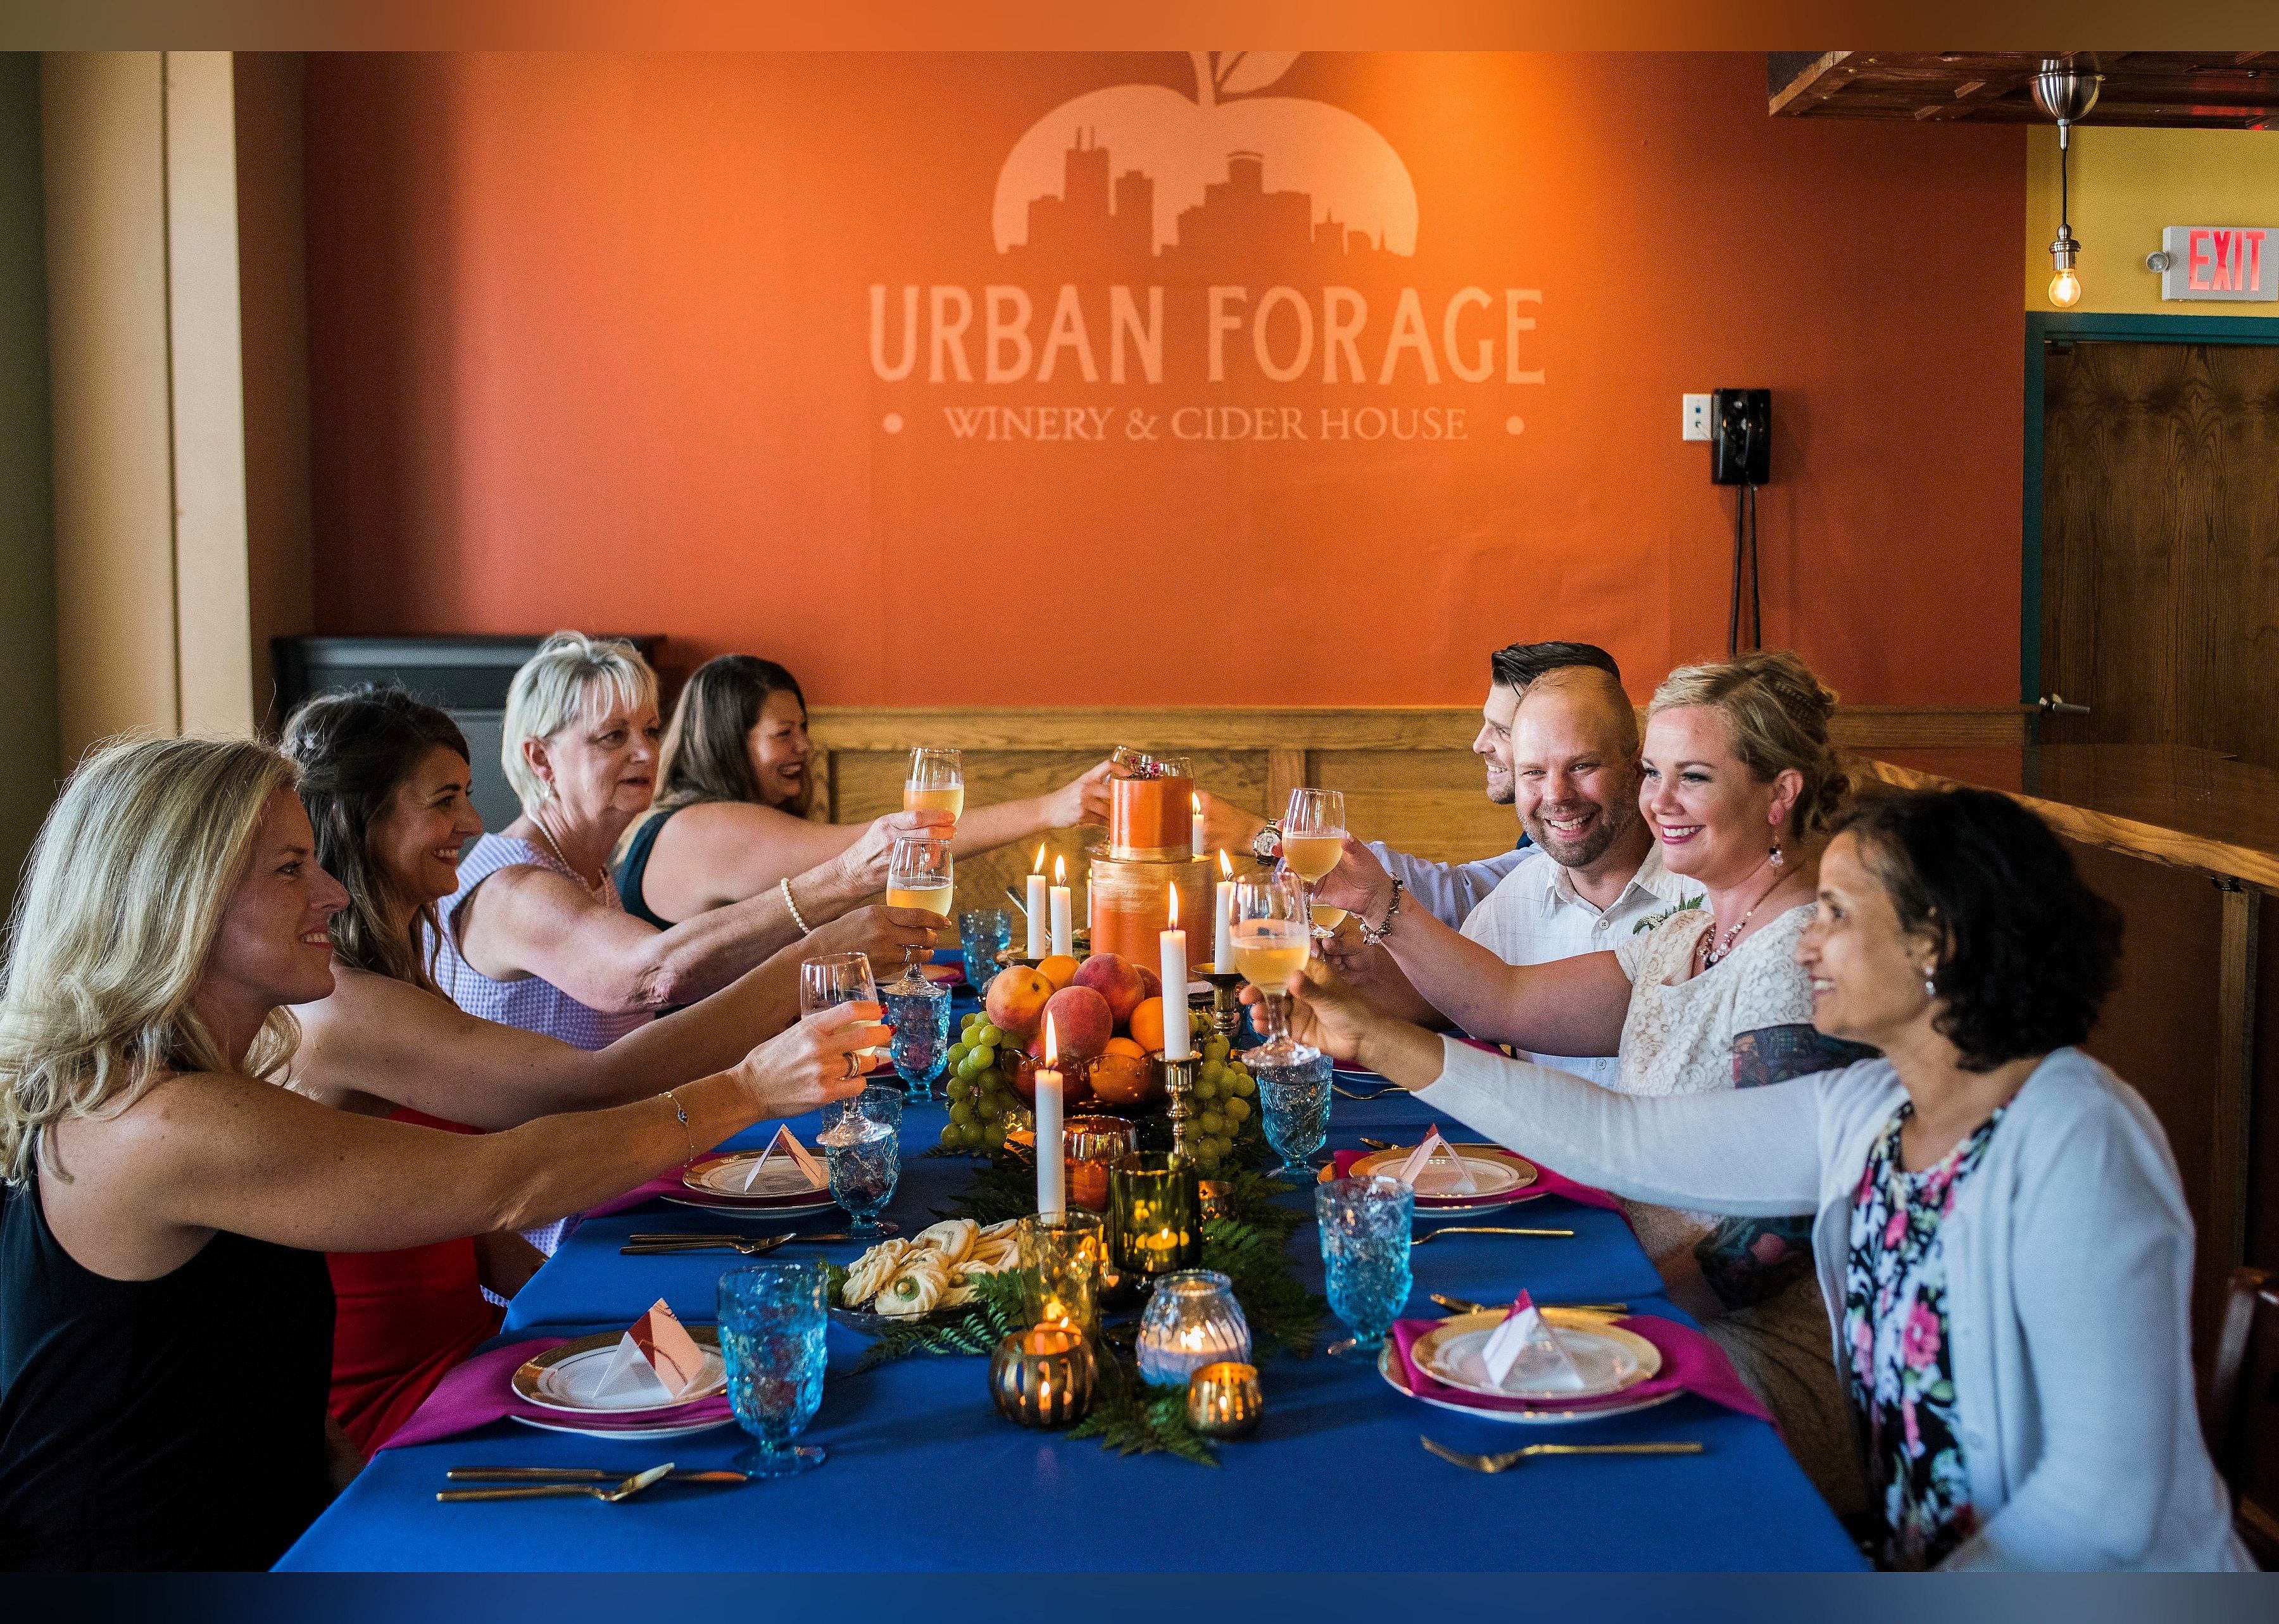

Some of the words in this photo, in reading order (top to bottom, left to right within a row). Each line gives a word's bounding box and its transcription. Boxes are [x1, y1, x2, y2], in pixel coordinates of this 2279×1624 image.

[2188, 229, 2266, 291] EXIT
[869, 284, 1164, 384] URBAN
[1208, 285, 1545, 385] FORAGE
[943, 407, 1114, 441] WINERY
[1125, 407, 1160, 442] &
[1171, 408, 1308, 442] CIDER
[1319, 408, 1468, 441] HOUSE
